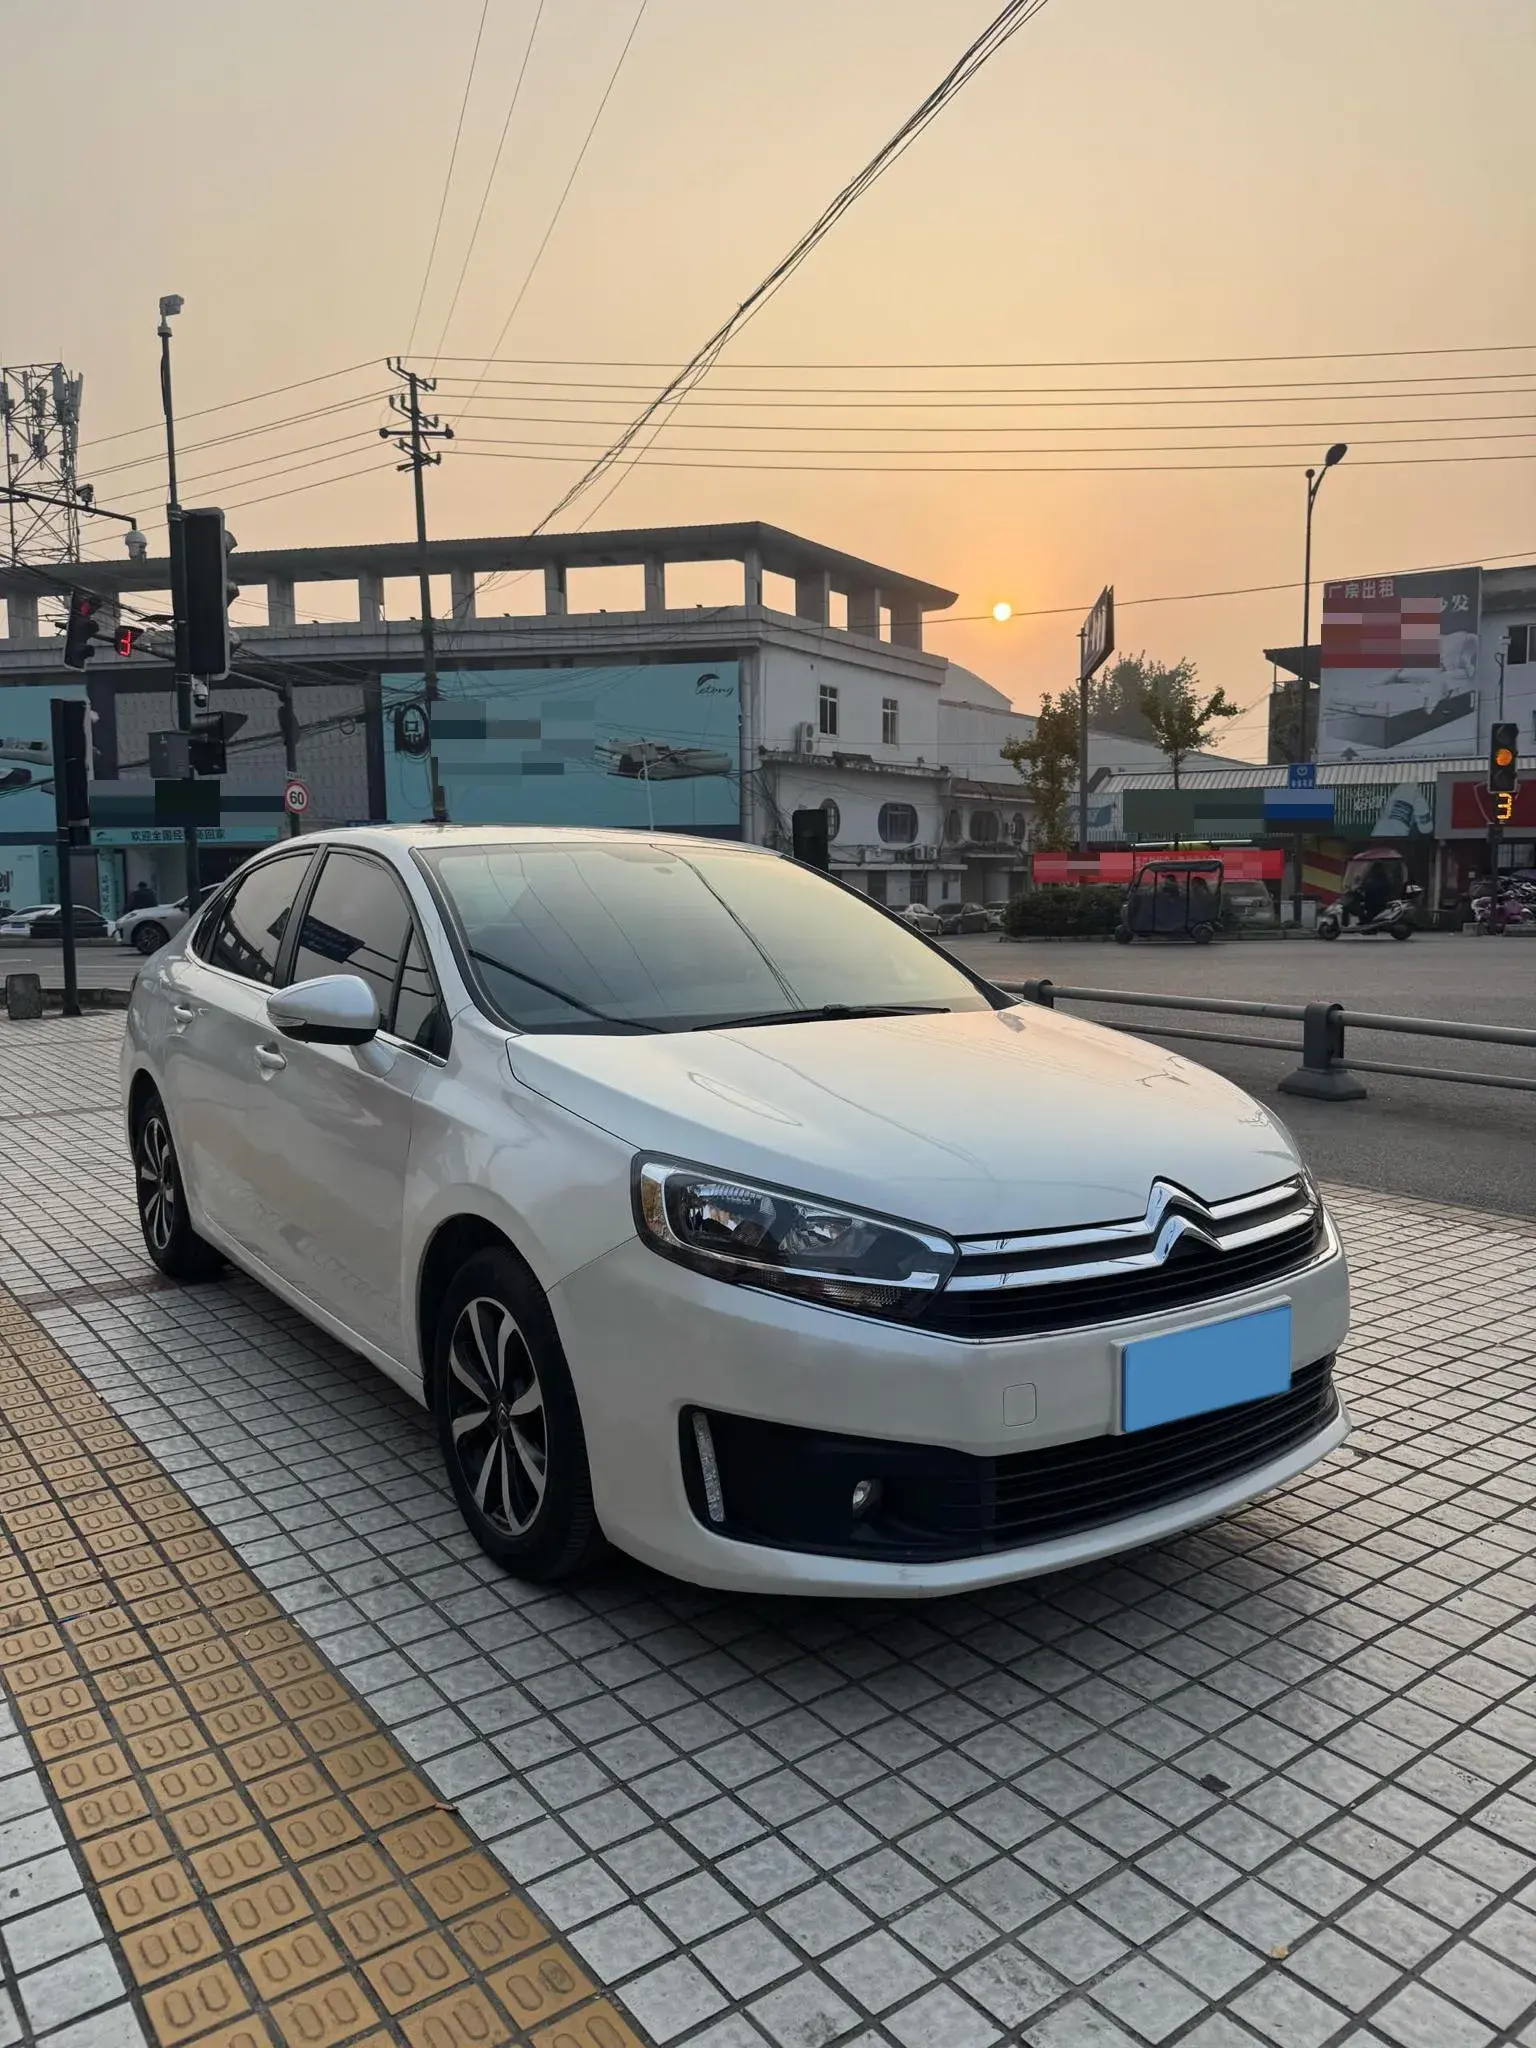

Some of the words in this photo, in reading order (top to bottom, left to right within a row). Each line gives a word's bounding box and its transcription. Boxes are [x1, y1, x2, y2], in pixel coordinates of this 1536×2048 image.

[1328, 579, 1395, 599] 厂房出租
[1440, 594, 1469, 612] 发
[290, 791, 305, 805] 60
[1496, 793, 1512, 819] 3
